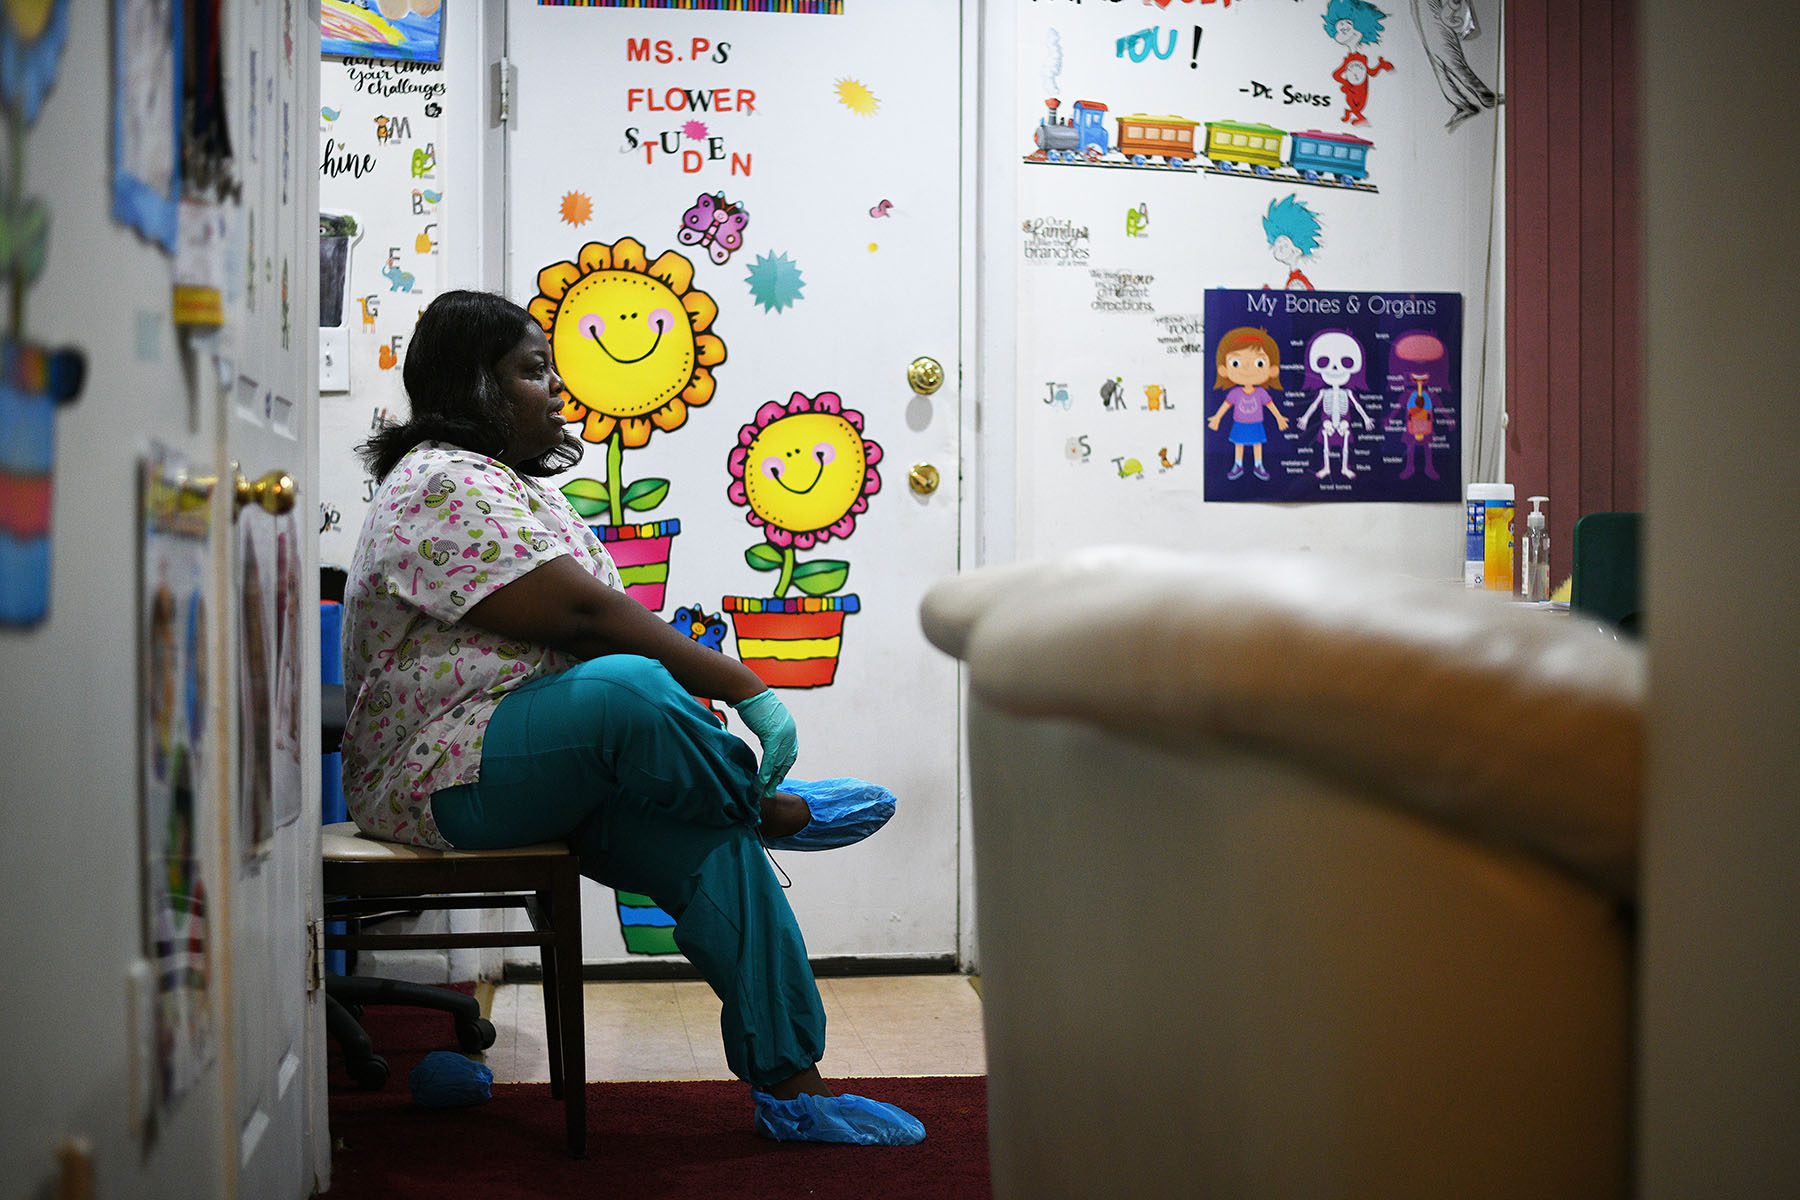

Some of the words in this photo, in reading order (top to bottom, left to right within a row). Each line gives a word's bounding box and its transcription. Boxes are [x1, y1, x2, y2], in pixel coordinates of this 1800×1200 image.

[627, 87, 757, 113] FLOWER
[1283, 84, 1331, 107] Seuss
[1247, 293, 1277, 316] My
[1285, 294, 1340, 314] Bones
[1346, 296, 1360, 315] &
[1368, 296, 1436, 318] Organs
